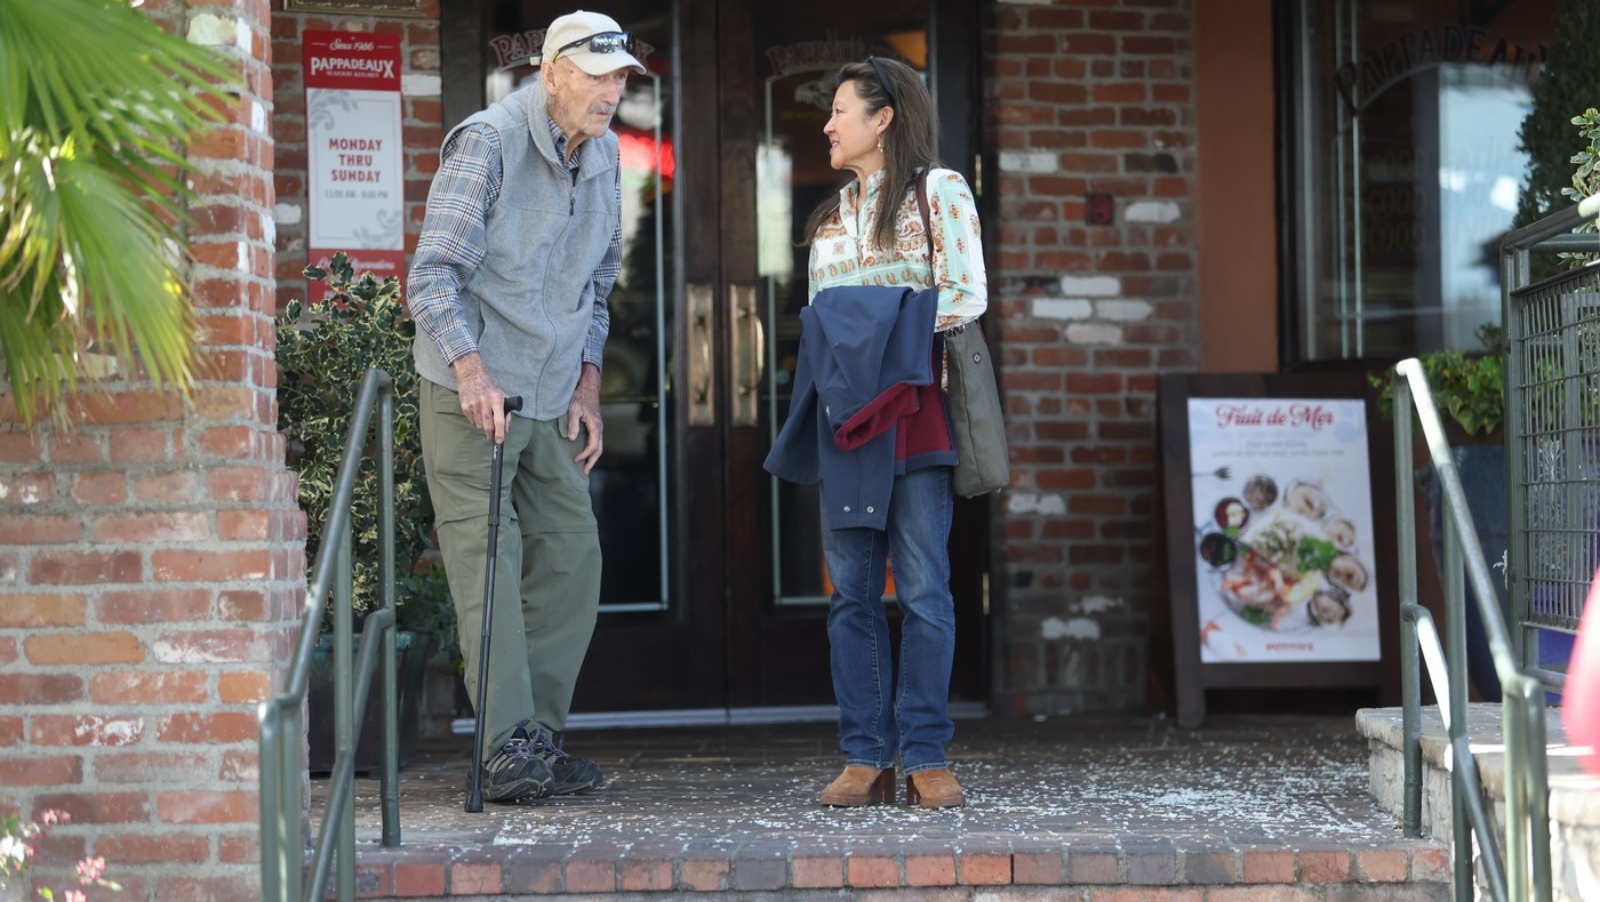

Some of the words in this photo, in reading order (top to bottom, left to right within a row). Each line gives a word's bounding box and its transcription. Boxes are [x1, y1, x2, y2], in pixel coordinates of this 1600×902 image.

[329, 38, 352, 51] Since
[353, 41, 375, 52] 1986
[311, 57, 395, 79] PAPPADEAUX
[1335, 24, 1549, 116] PAPPADEAU
[329, 138, 383, 151] MONDAY
[338, 154, 373, 167] THRU
[331, 169, 382, 183] SUNDAY
[345, 189, 356, 199] AM
[378, 190, 389, 200] PM
[1215, 403, 1262, 429] Fruit
[1267, 407, 1286, 426] de
[1288, 403, 1334, 432] Mer
